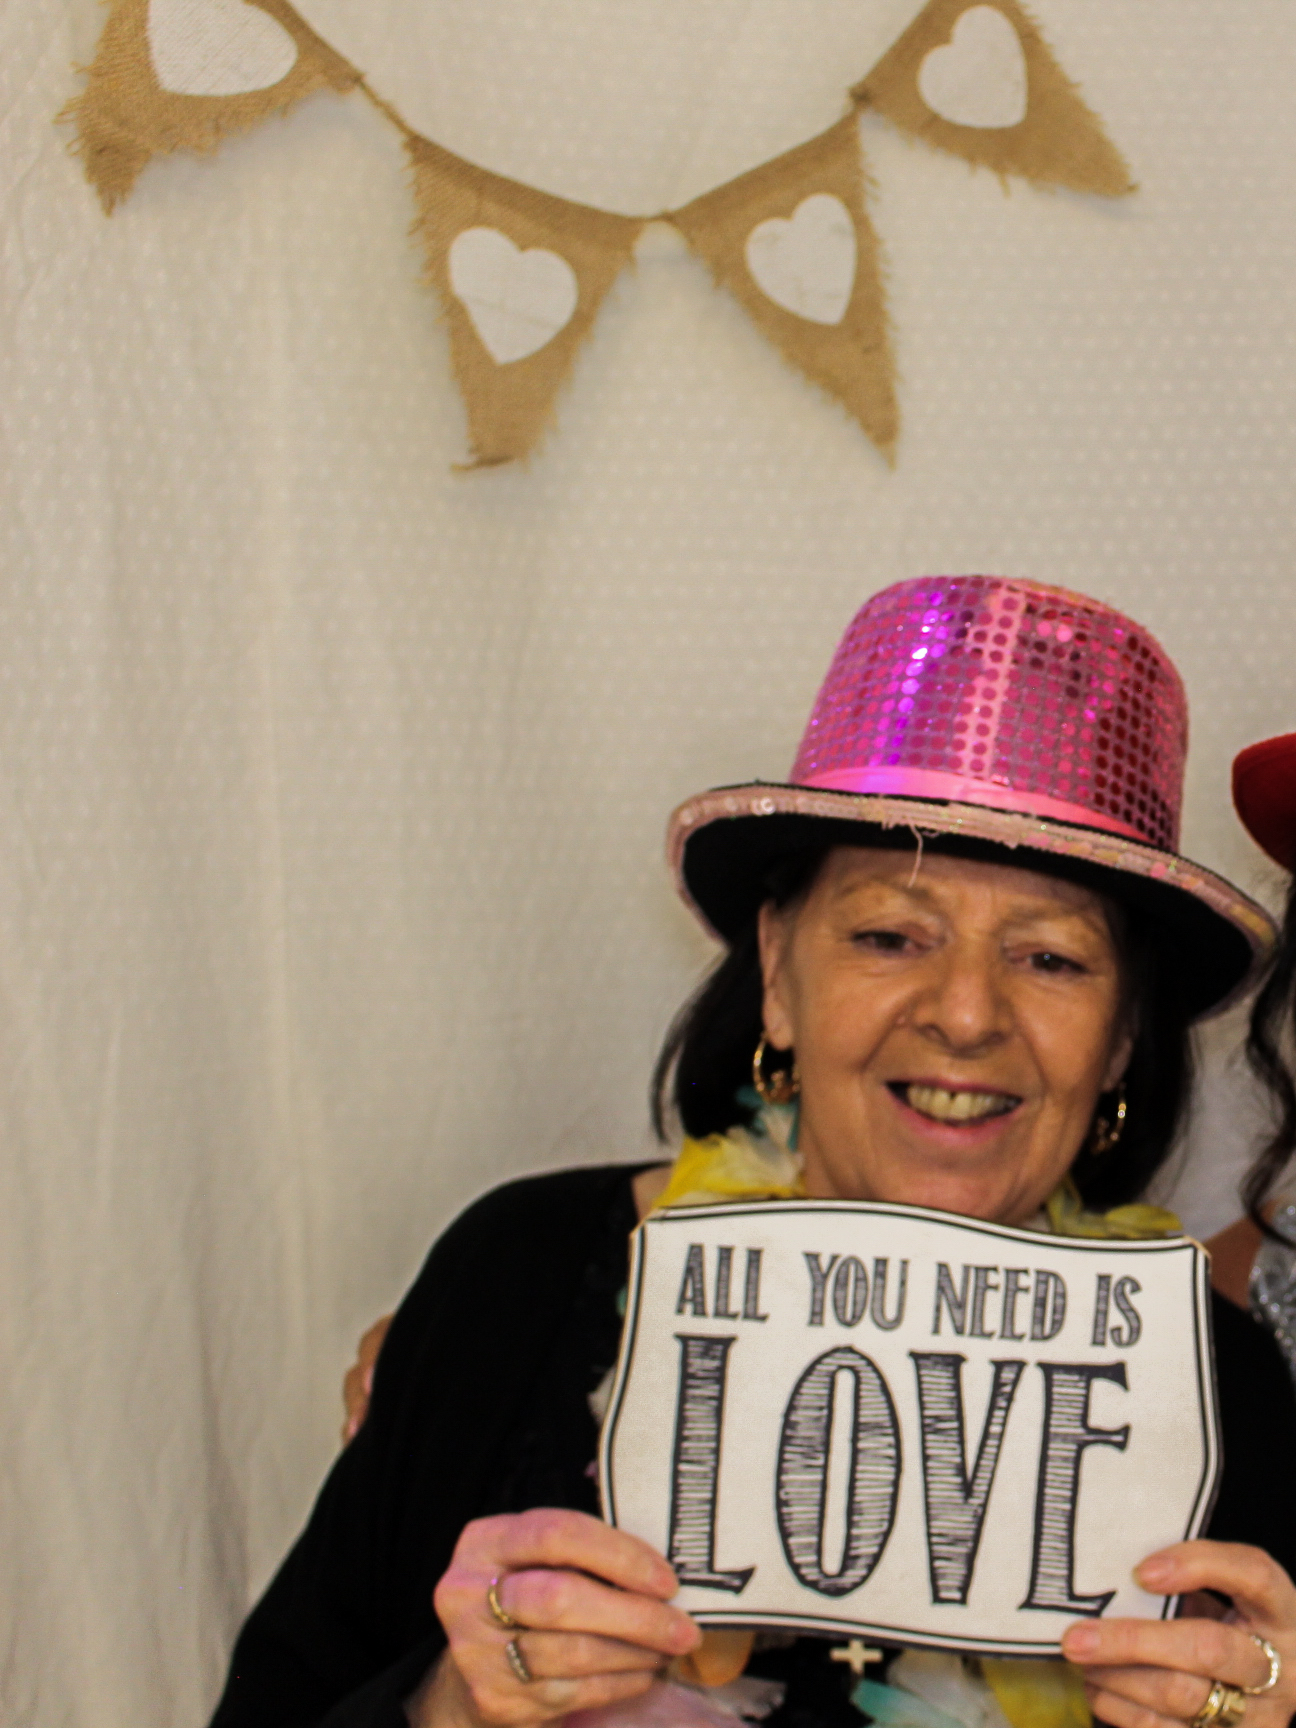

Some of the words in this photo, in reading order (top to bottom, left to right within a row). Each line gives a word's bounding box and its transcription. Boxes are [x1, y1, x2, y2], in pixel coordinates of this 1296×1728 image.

[676, 1244, 769, 1323] ALL
[803, 1252, 909, 1331] YOU
[932, 1262, 1067, 1342] NEED
[1091, 1274, 1142, 1348] IS
[667, 1333, 1132, 1618] LOVE
